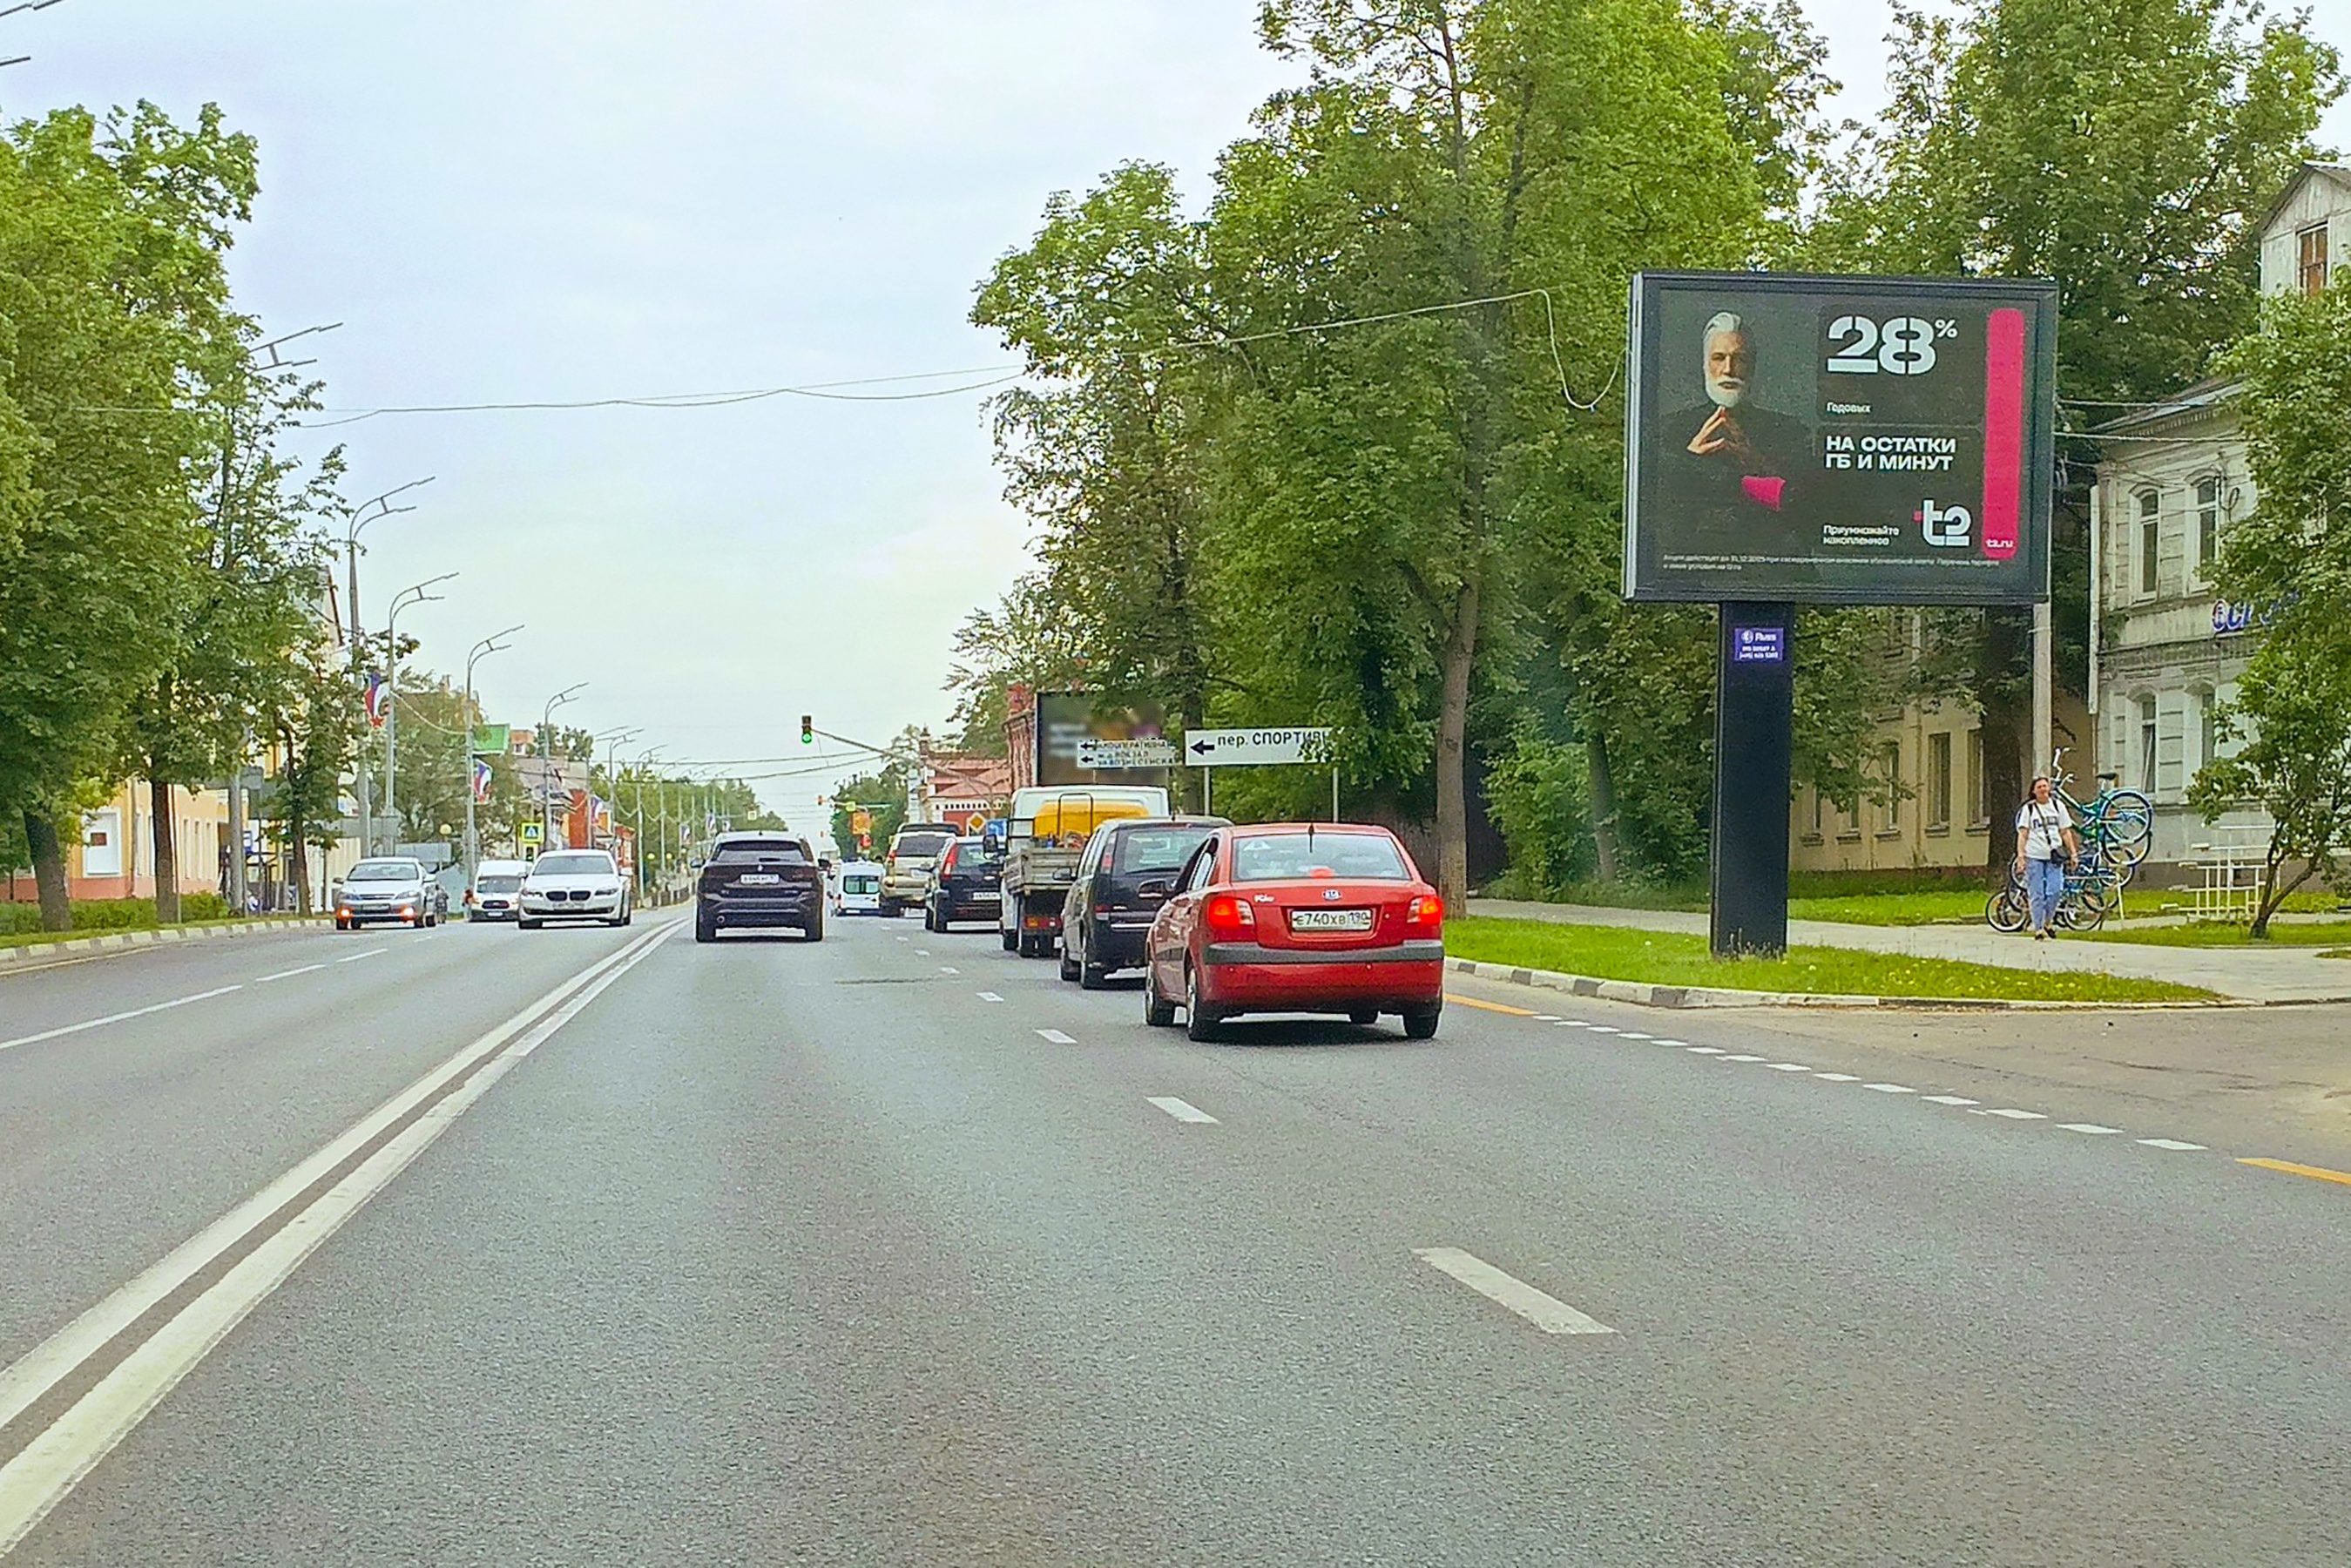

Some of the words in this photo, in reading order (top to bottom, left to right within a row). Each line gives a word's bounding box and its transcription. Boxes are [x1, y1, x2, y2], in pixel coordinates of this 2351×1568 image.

[1826, 402, 1871, 415] Годовых
[1826, 435, 1855, 451] НА
[1860, 436, 1956, 454] ОСТАТКИ
[1825, 452, 1852, 470] ГБ
[1856, 453, 1873, 470] И
[1878, 454, 1954, 471] МИНУТ
[1914, 499, 1972, 547] t2
[1217, 734, 1249, 748] пер.
